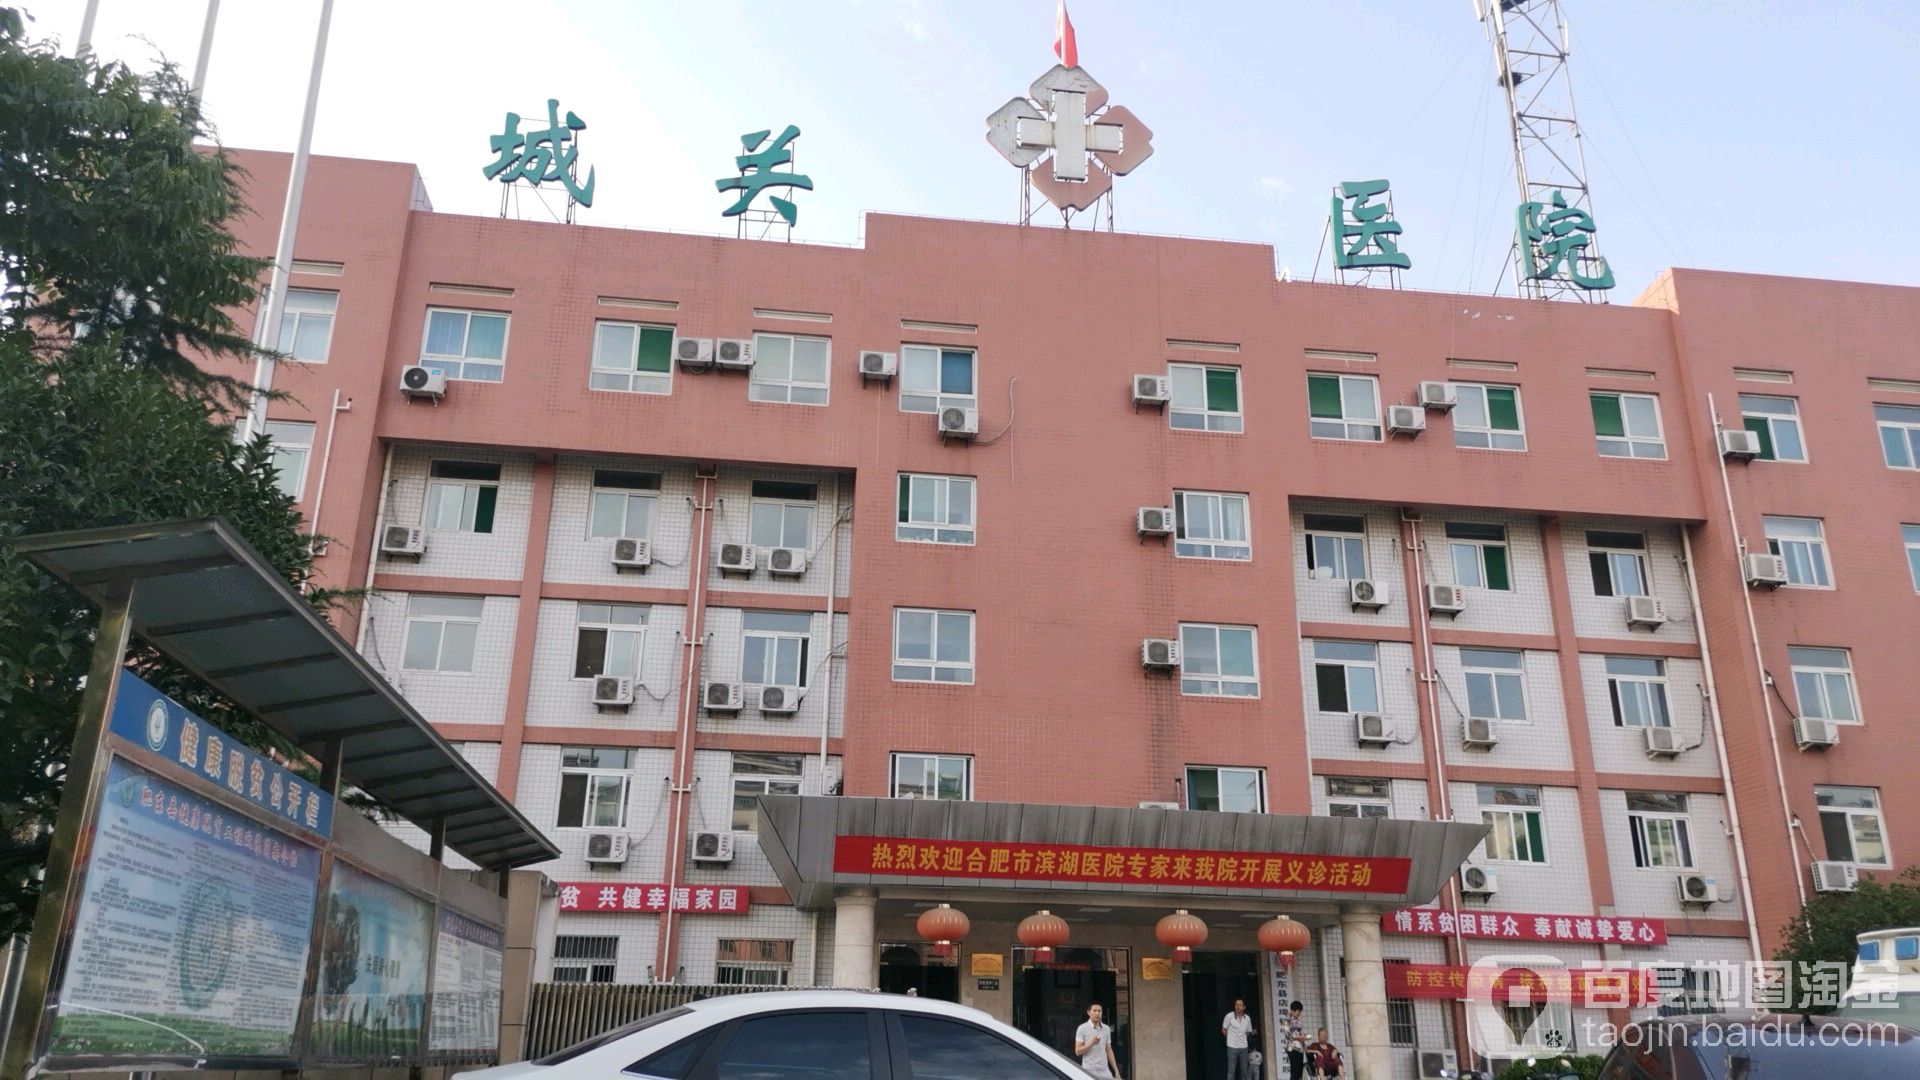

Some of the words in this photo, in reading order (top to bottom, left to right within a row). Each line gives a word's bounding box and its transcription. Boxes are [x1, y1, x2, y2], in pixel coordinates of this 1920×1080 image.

[180, 717, 321, 829] 健康脱贫公开栏
[871, 842, 1373, 887] 热烈欢迎合肥市滨湖医院专家来我院开展义诊活动
[598, 886, 738, 911] 共健幸福家园
[1395, 910, 1520, 937] 情系贫困群众
[1534, 916, 1656, 942] 奉献诚挚爱心
[1406, 969, 1504, 989] 防控传染病
